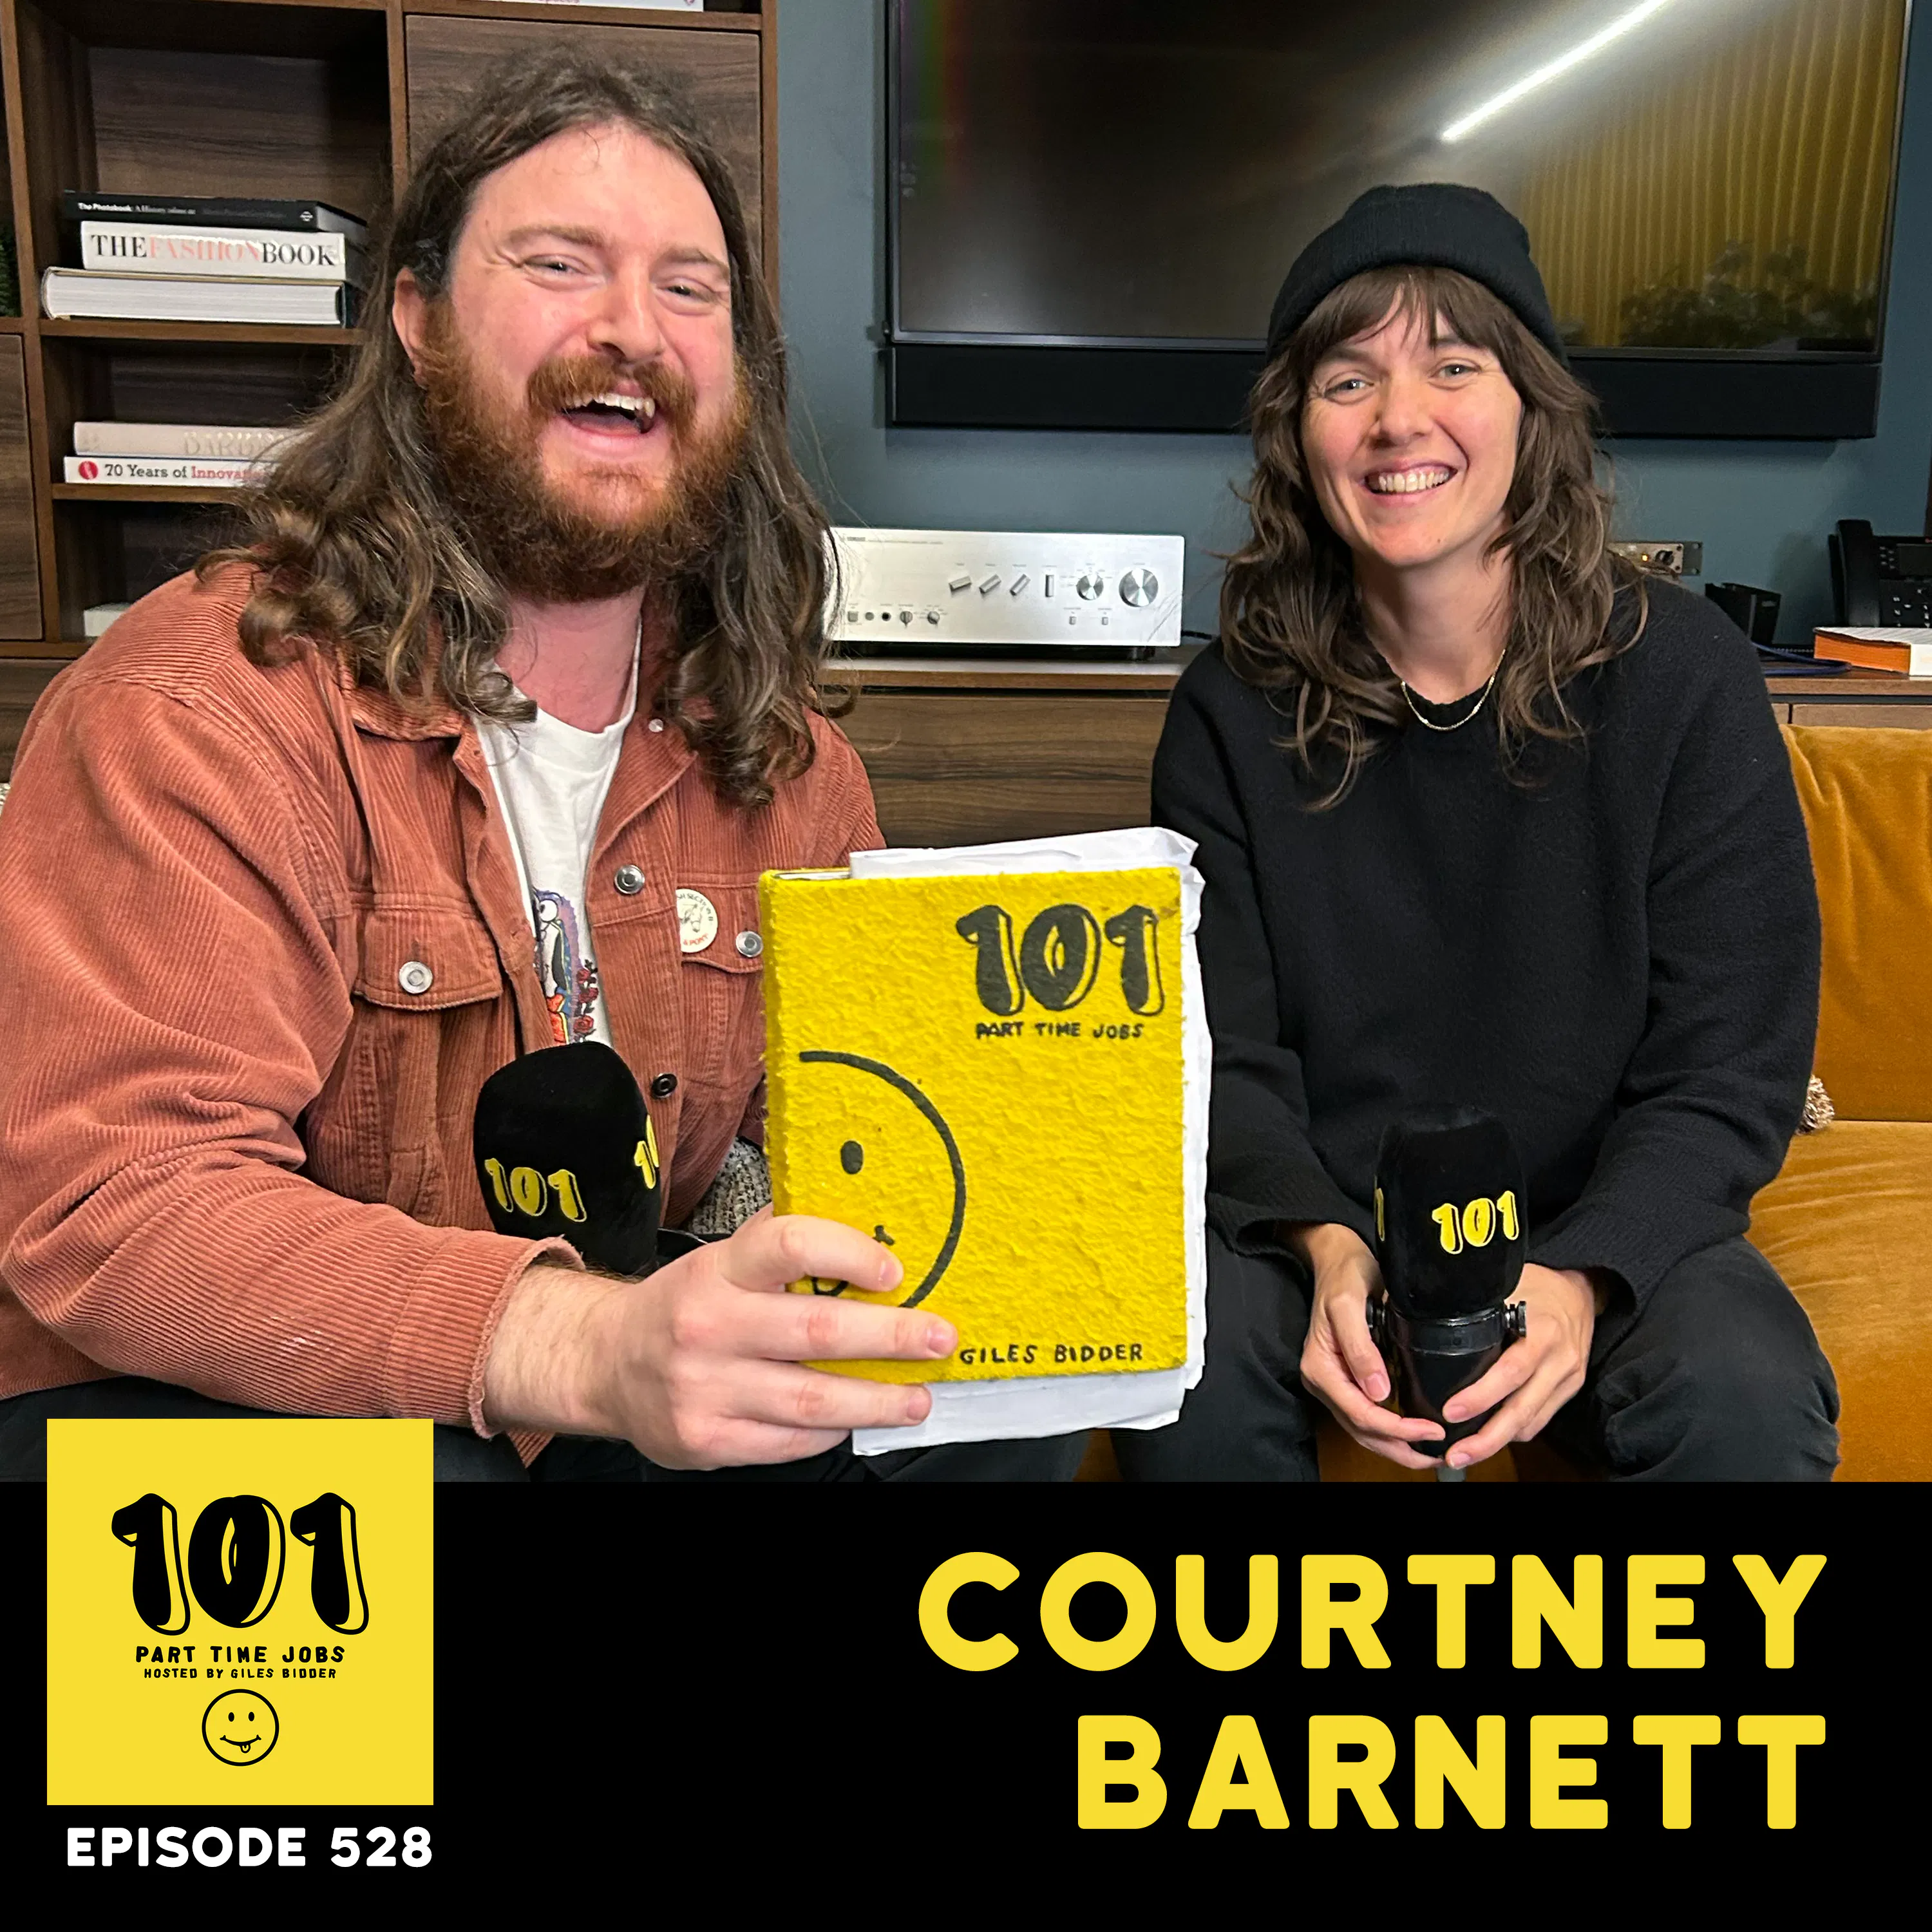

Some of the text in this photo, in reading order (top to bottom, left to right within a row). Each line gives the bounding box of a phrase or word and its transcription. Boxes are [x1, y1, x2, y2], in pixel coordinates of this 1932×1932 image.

[104, 464, 123, 477] 70
[127, 464, 169, 478] Years
[173, 466, 187, 478] of
[956, 903, 1166, 1016] 101
[976, 1021, 1145, 1039] PART TIME JOBS
[484, 1157, 587, 1223] 101
[1431, 1190, 1520, 1255] 101
[959, 1343, 1143, 1365] GILES BIDDER
